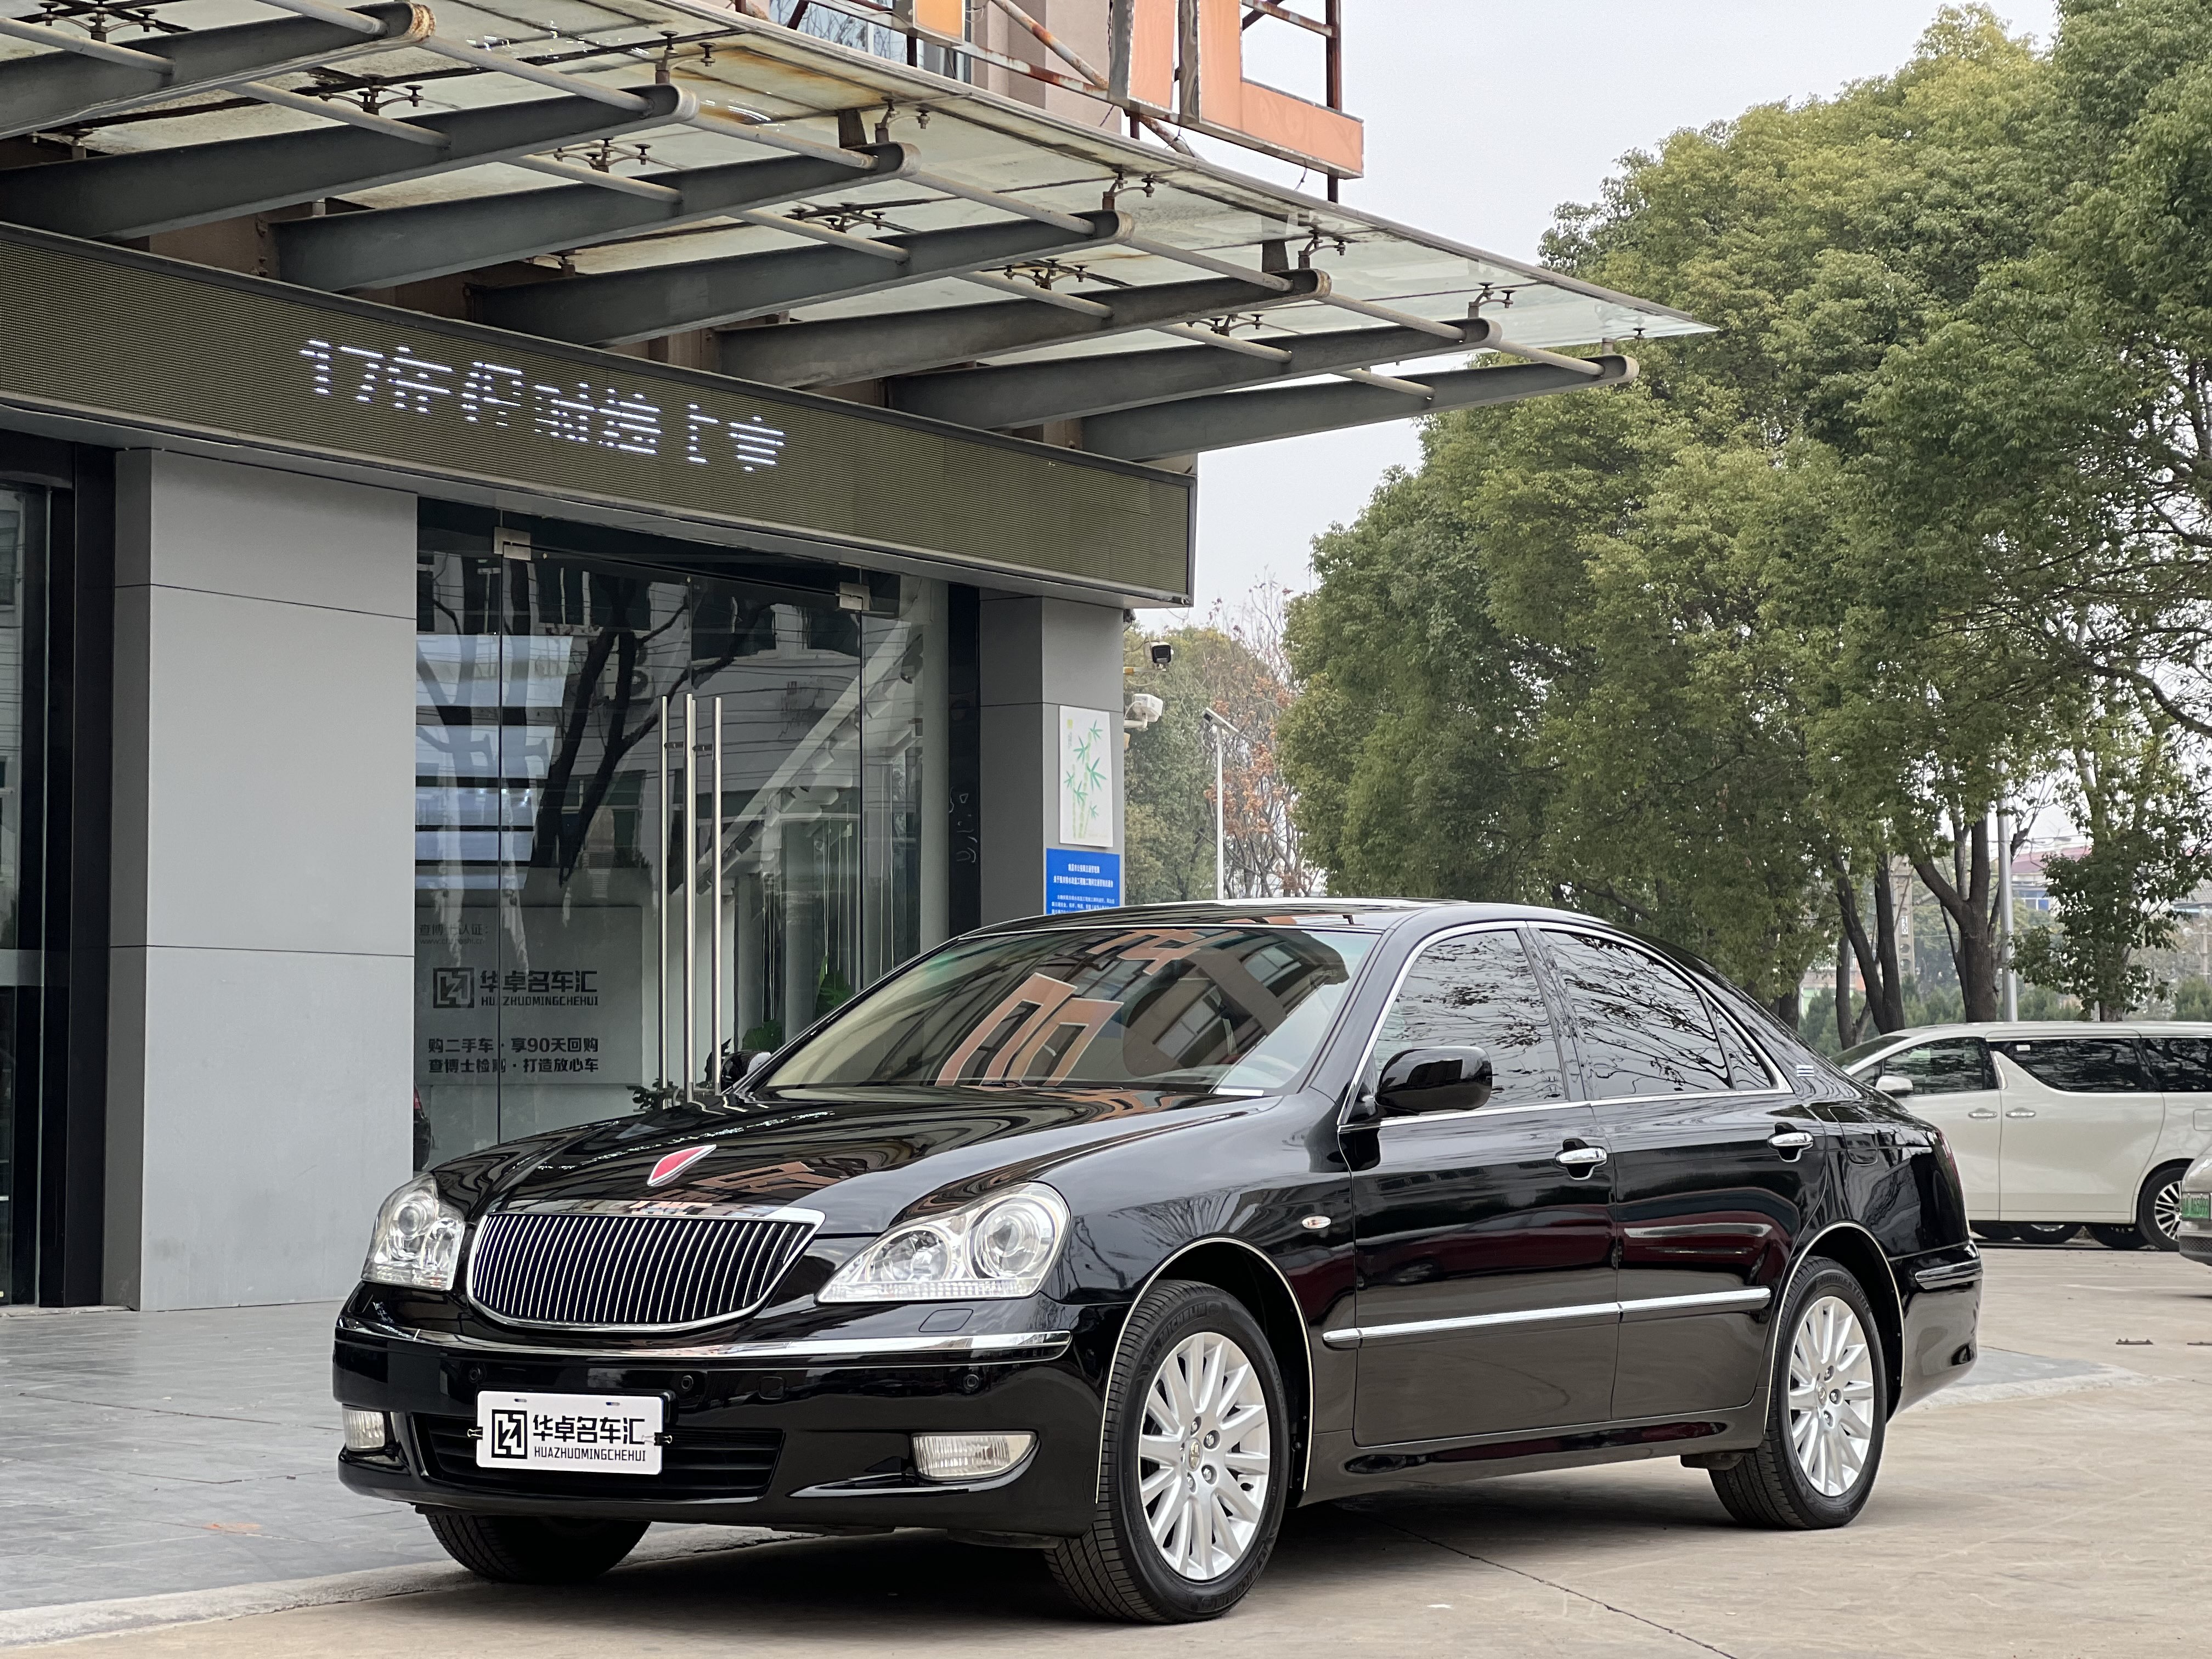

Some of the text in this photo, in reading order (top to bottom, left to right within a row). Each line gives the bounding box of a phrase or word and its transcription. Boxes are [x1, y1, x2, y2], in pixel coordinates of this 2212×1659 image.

[479, 970, 597, 993] 华卓名车汇
[481, 996, 598, 1006] HUZHUOMINGCHEHUI
[1159, 1303, 1207, 1345] MICHELIN
[533, 1414, 645, 1444] 华卓名车汇
[534, 1446, 646, 1462] HUAZHUOMINGCHEHUI
